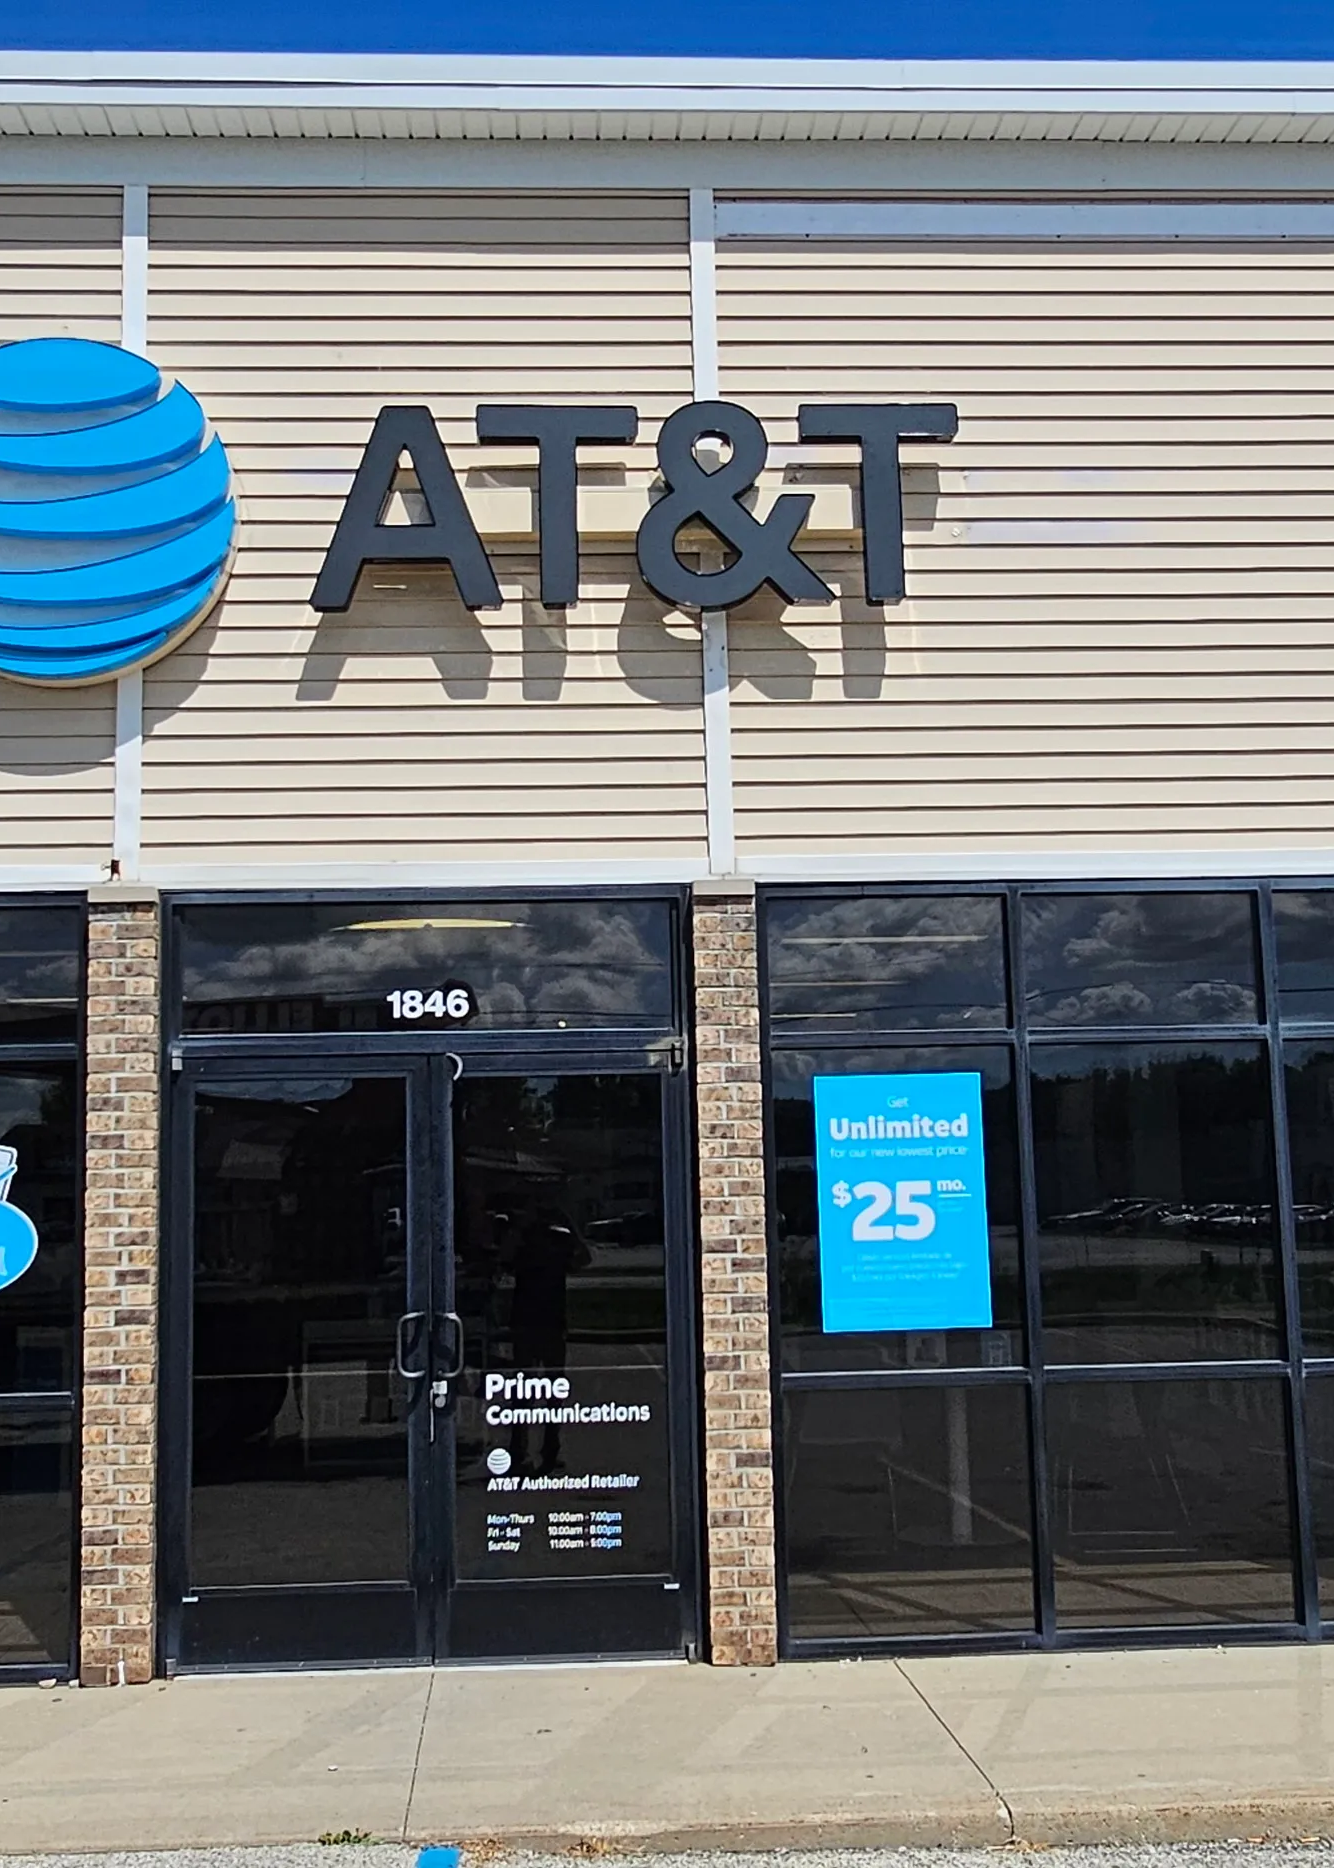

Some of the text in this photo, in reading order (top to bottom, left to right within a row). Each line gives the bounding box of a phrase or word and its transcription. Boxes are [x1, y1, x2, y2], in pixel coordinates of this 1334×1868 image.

[310, 401, 958, 613] AT&T
[386, 989, 470, 1019] 1846
[887, 1096, 909, 1108] Get
[829, 1112, 969, 1141] Unlimited
[871, 1148, 895, 1158] new
[831, 1179, 967, 1242] $25 mo.
[485, 1371, 570, 1400] Prime
[485, 1402, 651, 1425] Communications
[486, 1473, 641, 1491] AT&T Authorized Retailer
